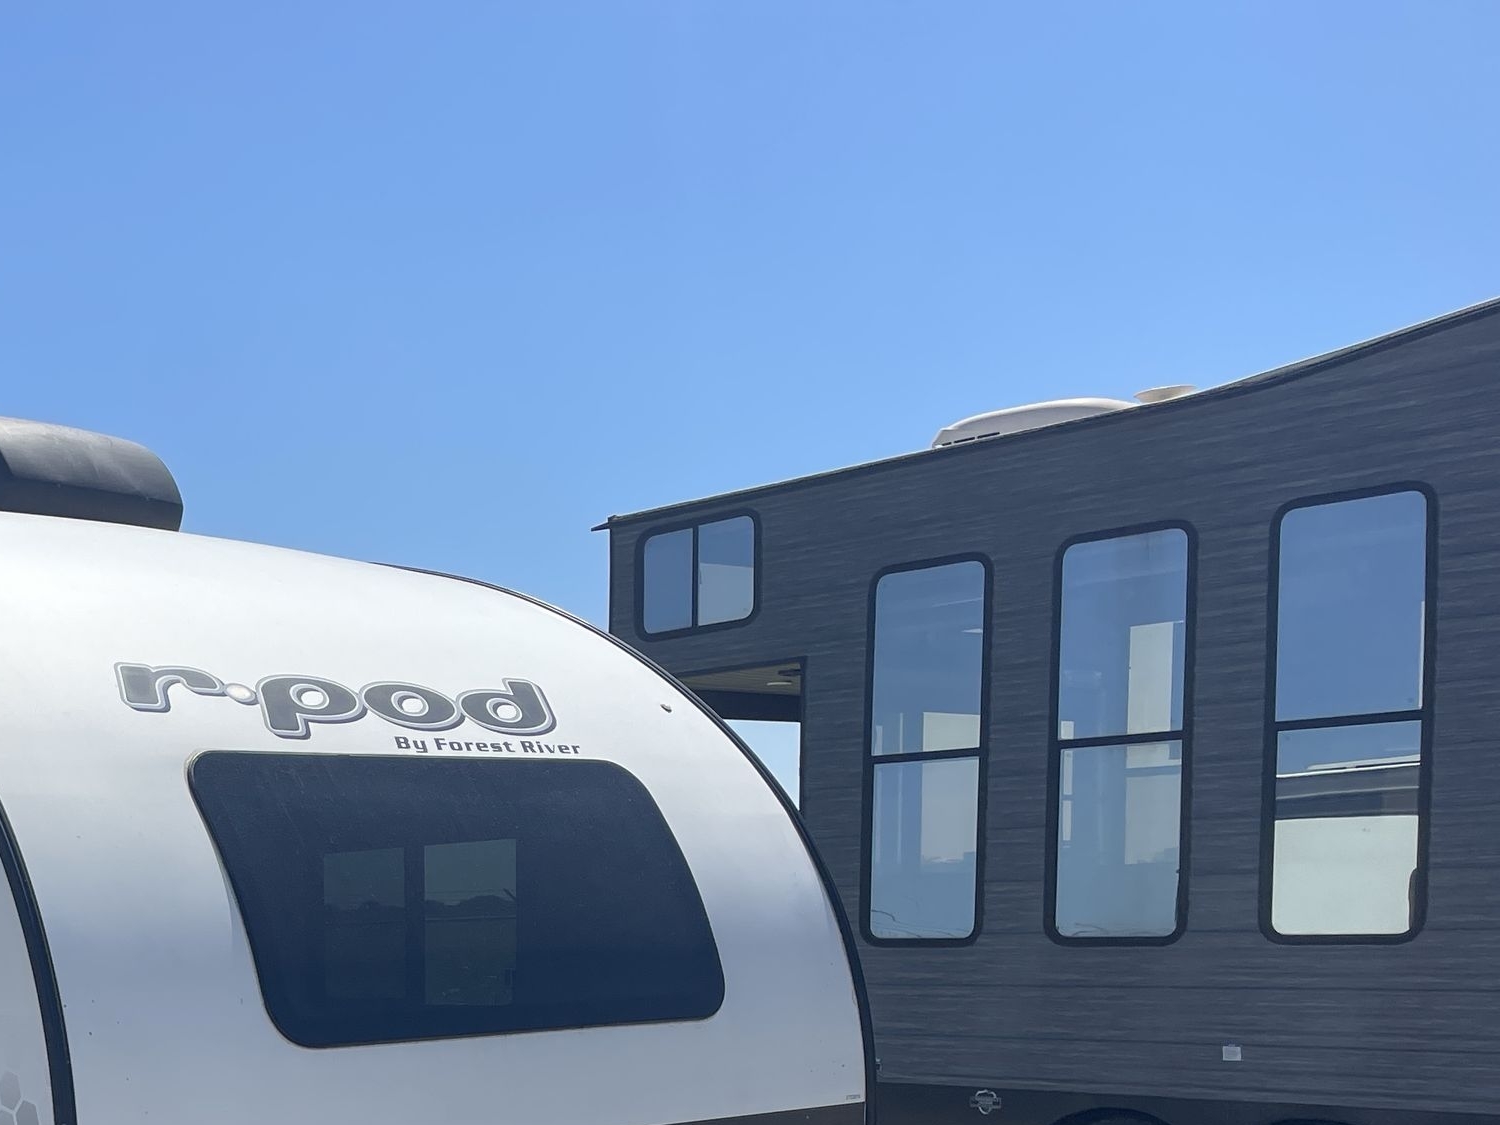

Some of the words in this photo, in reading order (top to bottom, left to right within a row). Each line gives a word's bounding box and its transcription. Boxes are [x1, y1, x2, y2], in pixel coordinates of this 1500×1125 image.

[394, 736, 428, 753] By
[433, 737, 516, 753] Forest
[520, 740, 580, 755] River
